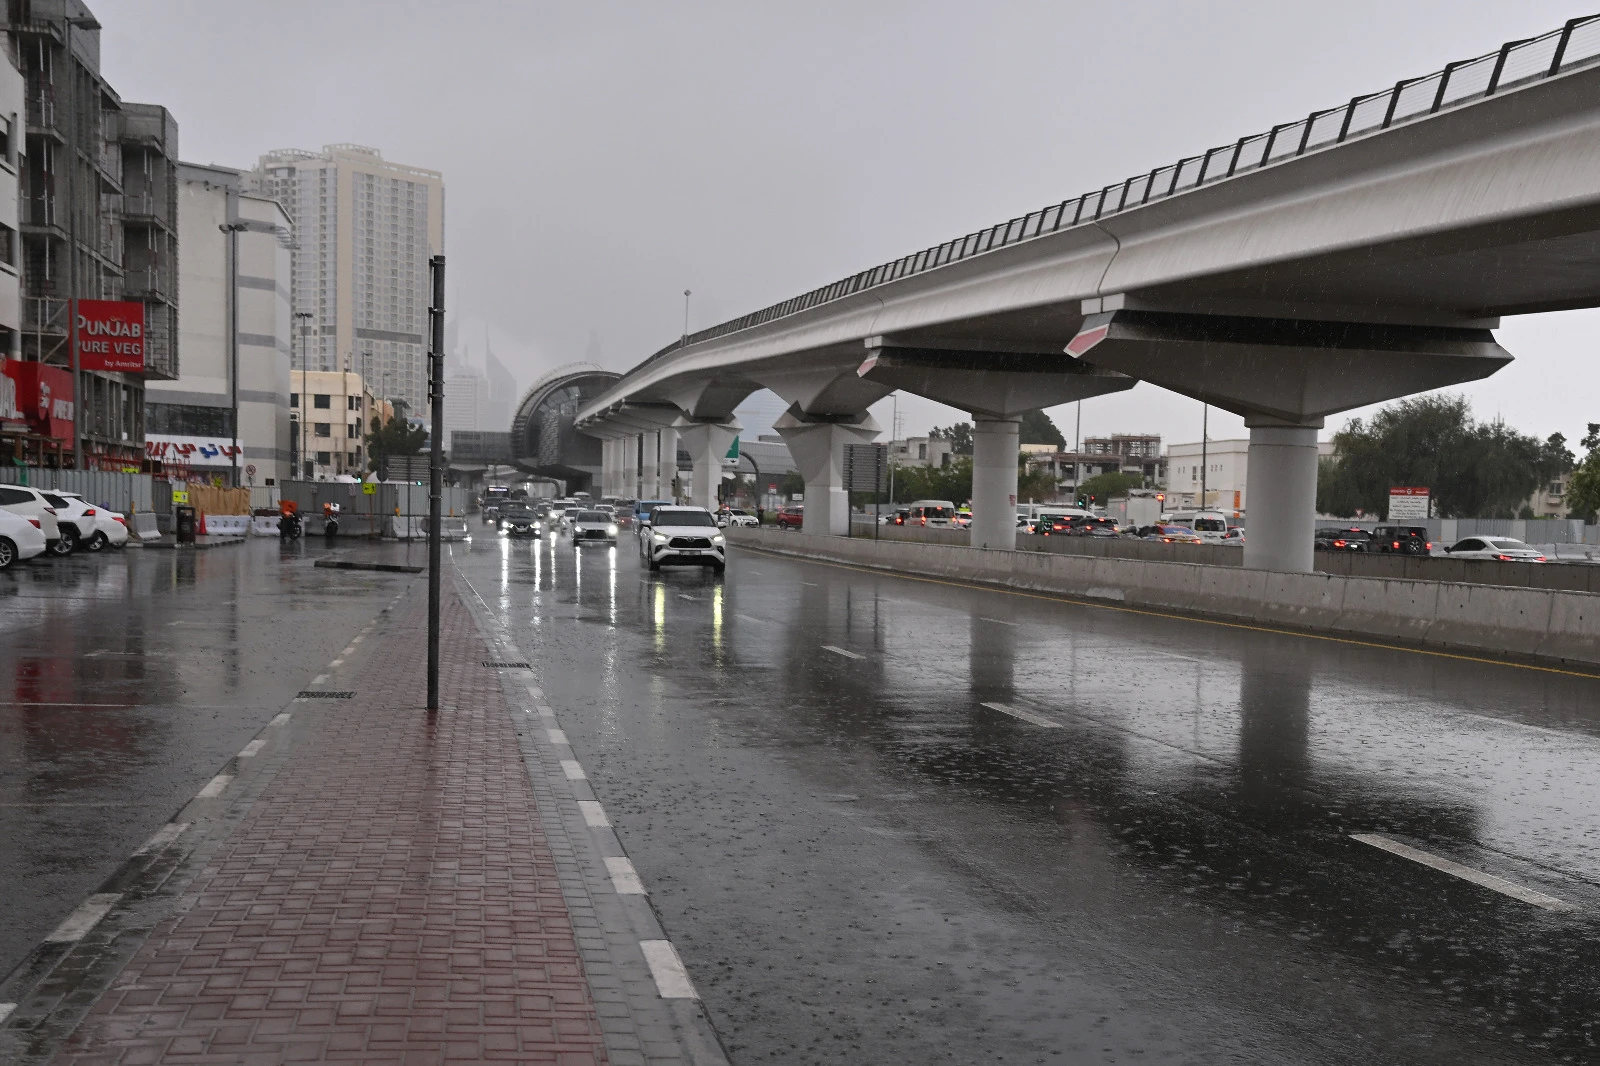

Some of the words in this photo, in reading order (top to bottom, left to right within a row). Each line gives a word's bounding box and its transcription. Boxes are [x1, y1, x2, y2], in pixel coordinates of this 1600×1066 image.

[78, 314, 141, 337] PUNJAB
[79, 340, 109, 353] URE
[113, 341, 141, 355] VEG
